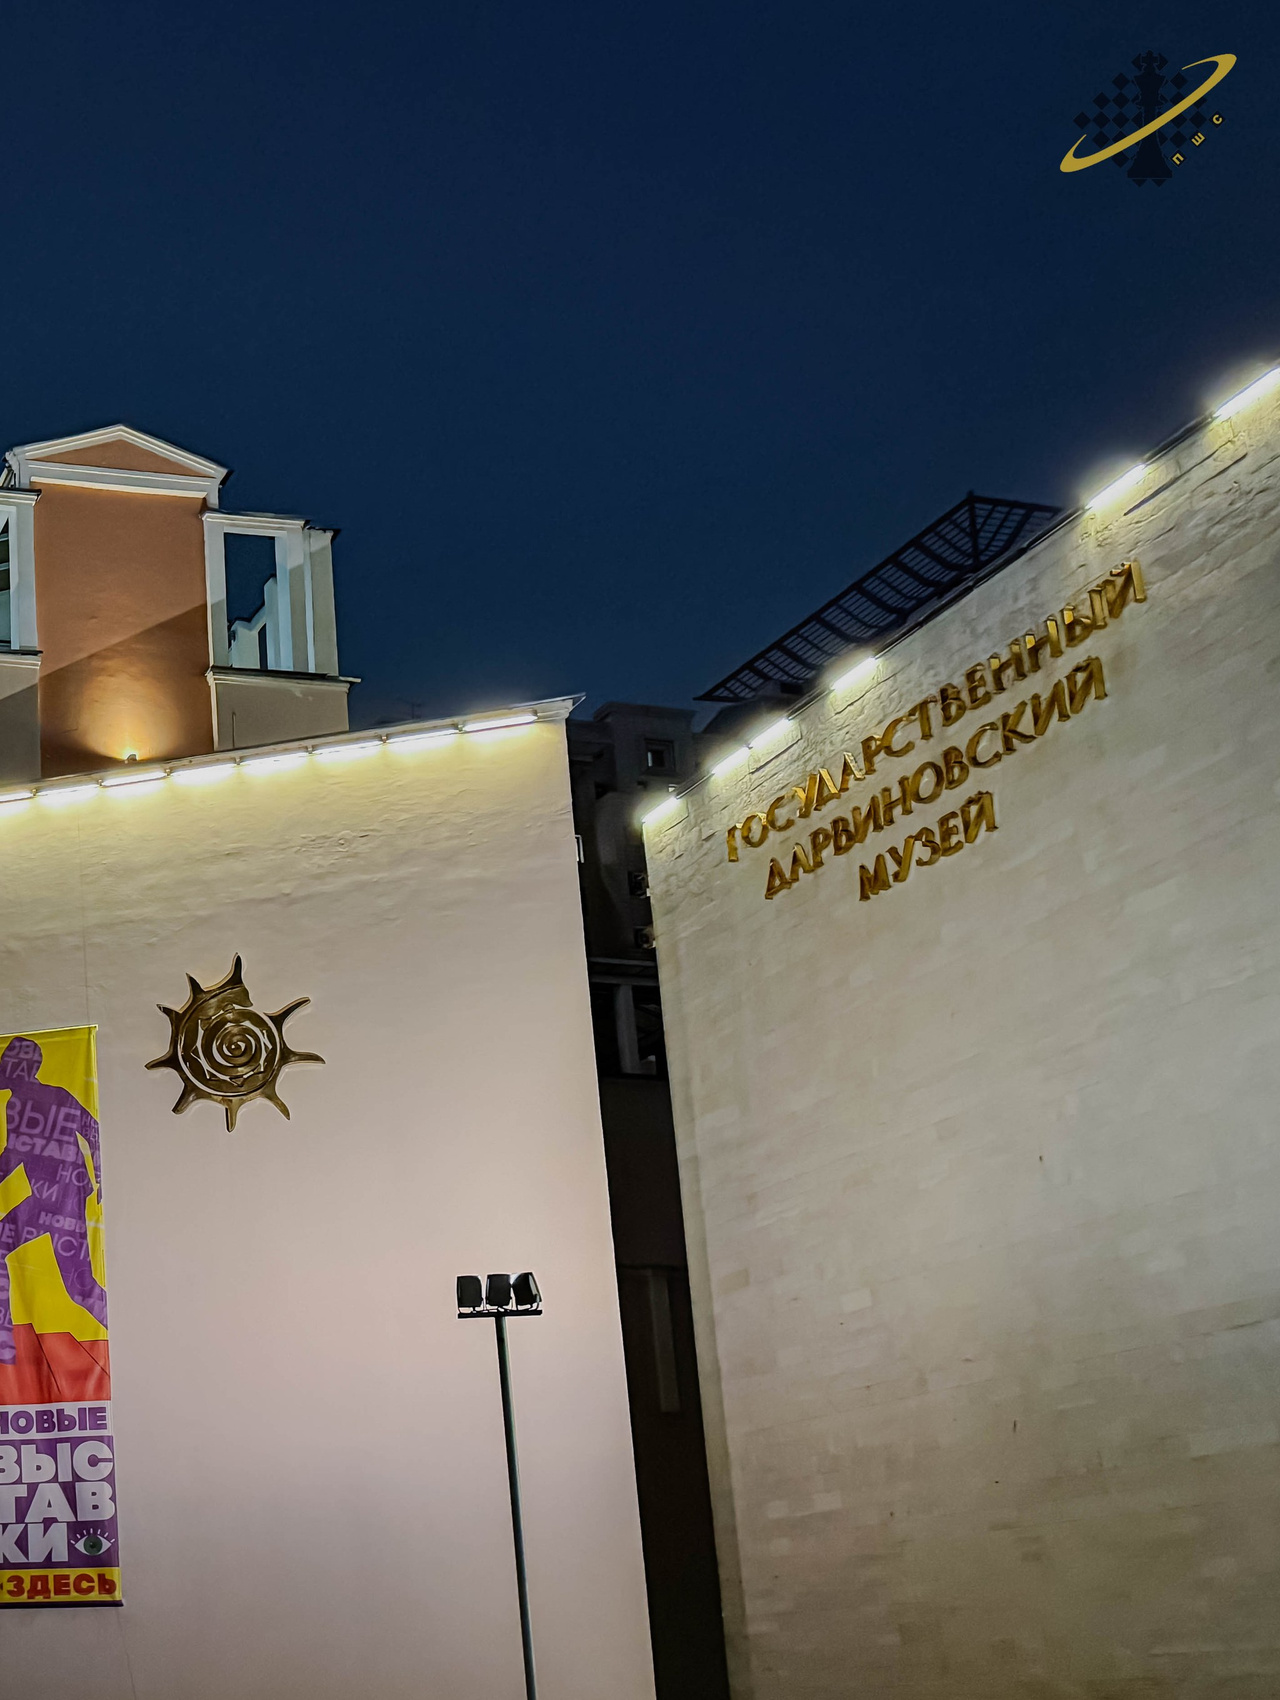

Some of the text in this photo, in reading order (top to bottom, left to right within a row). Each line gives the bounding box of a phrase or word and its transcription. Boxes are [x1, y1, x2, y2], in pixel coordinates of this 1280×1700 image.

[725, 558, 1147, 862] ГОСУДАРСТВЕННЫЙ
[764, 655, 1107, 899] ДАРВИНОВСКИЙ
[859, 790, 998, 901] МУЗЕЙ
[6, 1573, 117, 1599] ЗДЕСЬ
